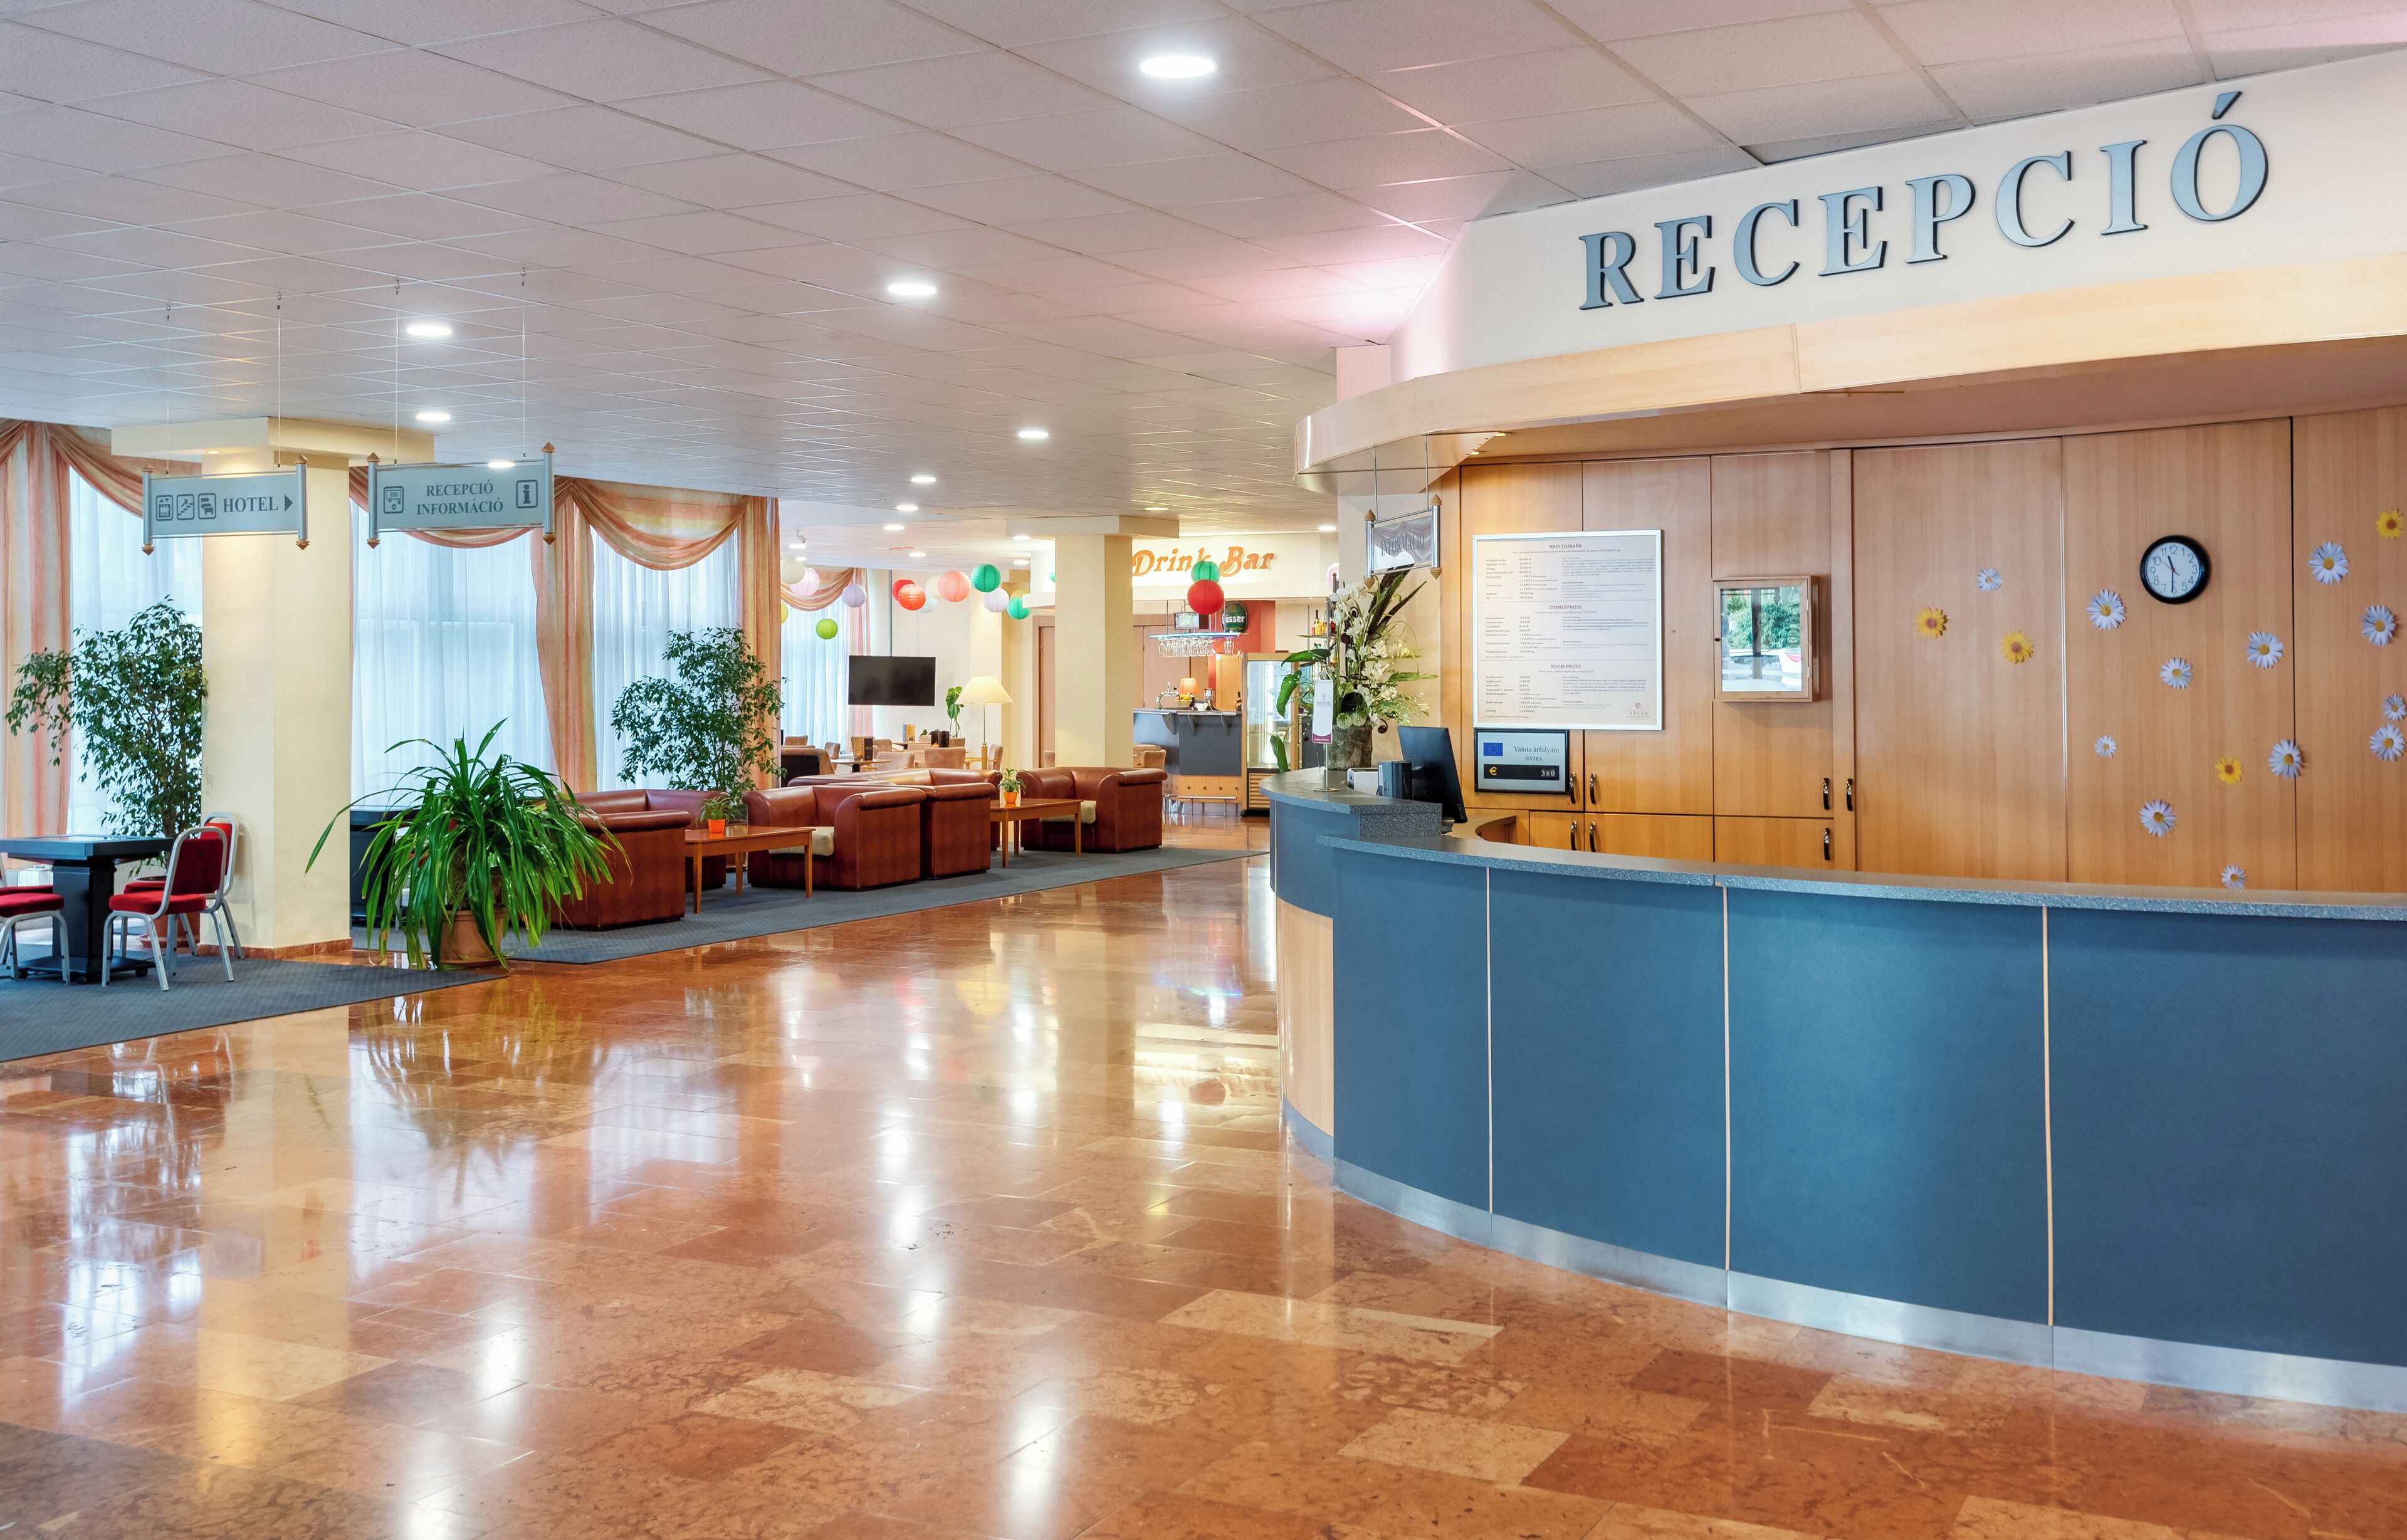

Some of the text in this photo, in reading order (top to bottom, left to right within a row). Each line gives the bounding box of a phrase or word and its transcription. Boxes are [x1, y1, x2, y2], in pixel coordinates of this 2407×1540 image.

[1578, 90, 2270, 312] RECEPCIÓ
[426, 479, 494, 496] RECEPCIÓ
[223, 496, 279, 513] HOTEL
[416, 497, 504, 515] INFORMÁCIÓ
[2161, 548, 2167, 556] 11
[2169, 545, 2177, 555] 12
[2182, 548, 2185, 557] 1
[1132, 546, 1275, 577] Drink Bar
[2153, 556, 2161, 566] 10
[2188, 554, 2194, 563] 2
[2150, 567, 2156, 575] 9
[2192, 565, 2198, 575] 3
[2153, 576, 2159, 585] 8
[2188, 576, 2194, 585] 4
[2162, 584, 2166, 592] 7
[2181, 582, 2187, 591] 5
